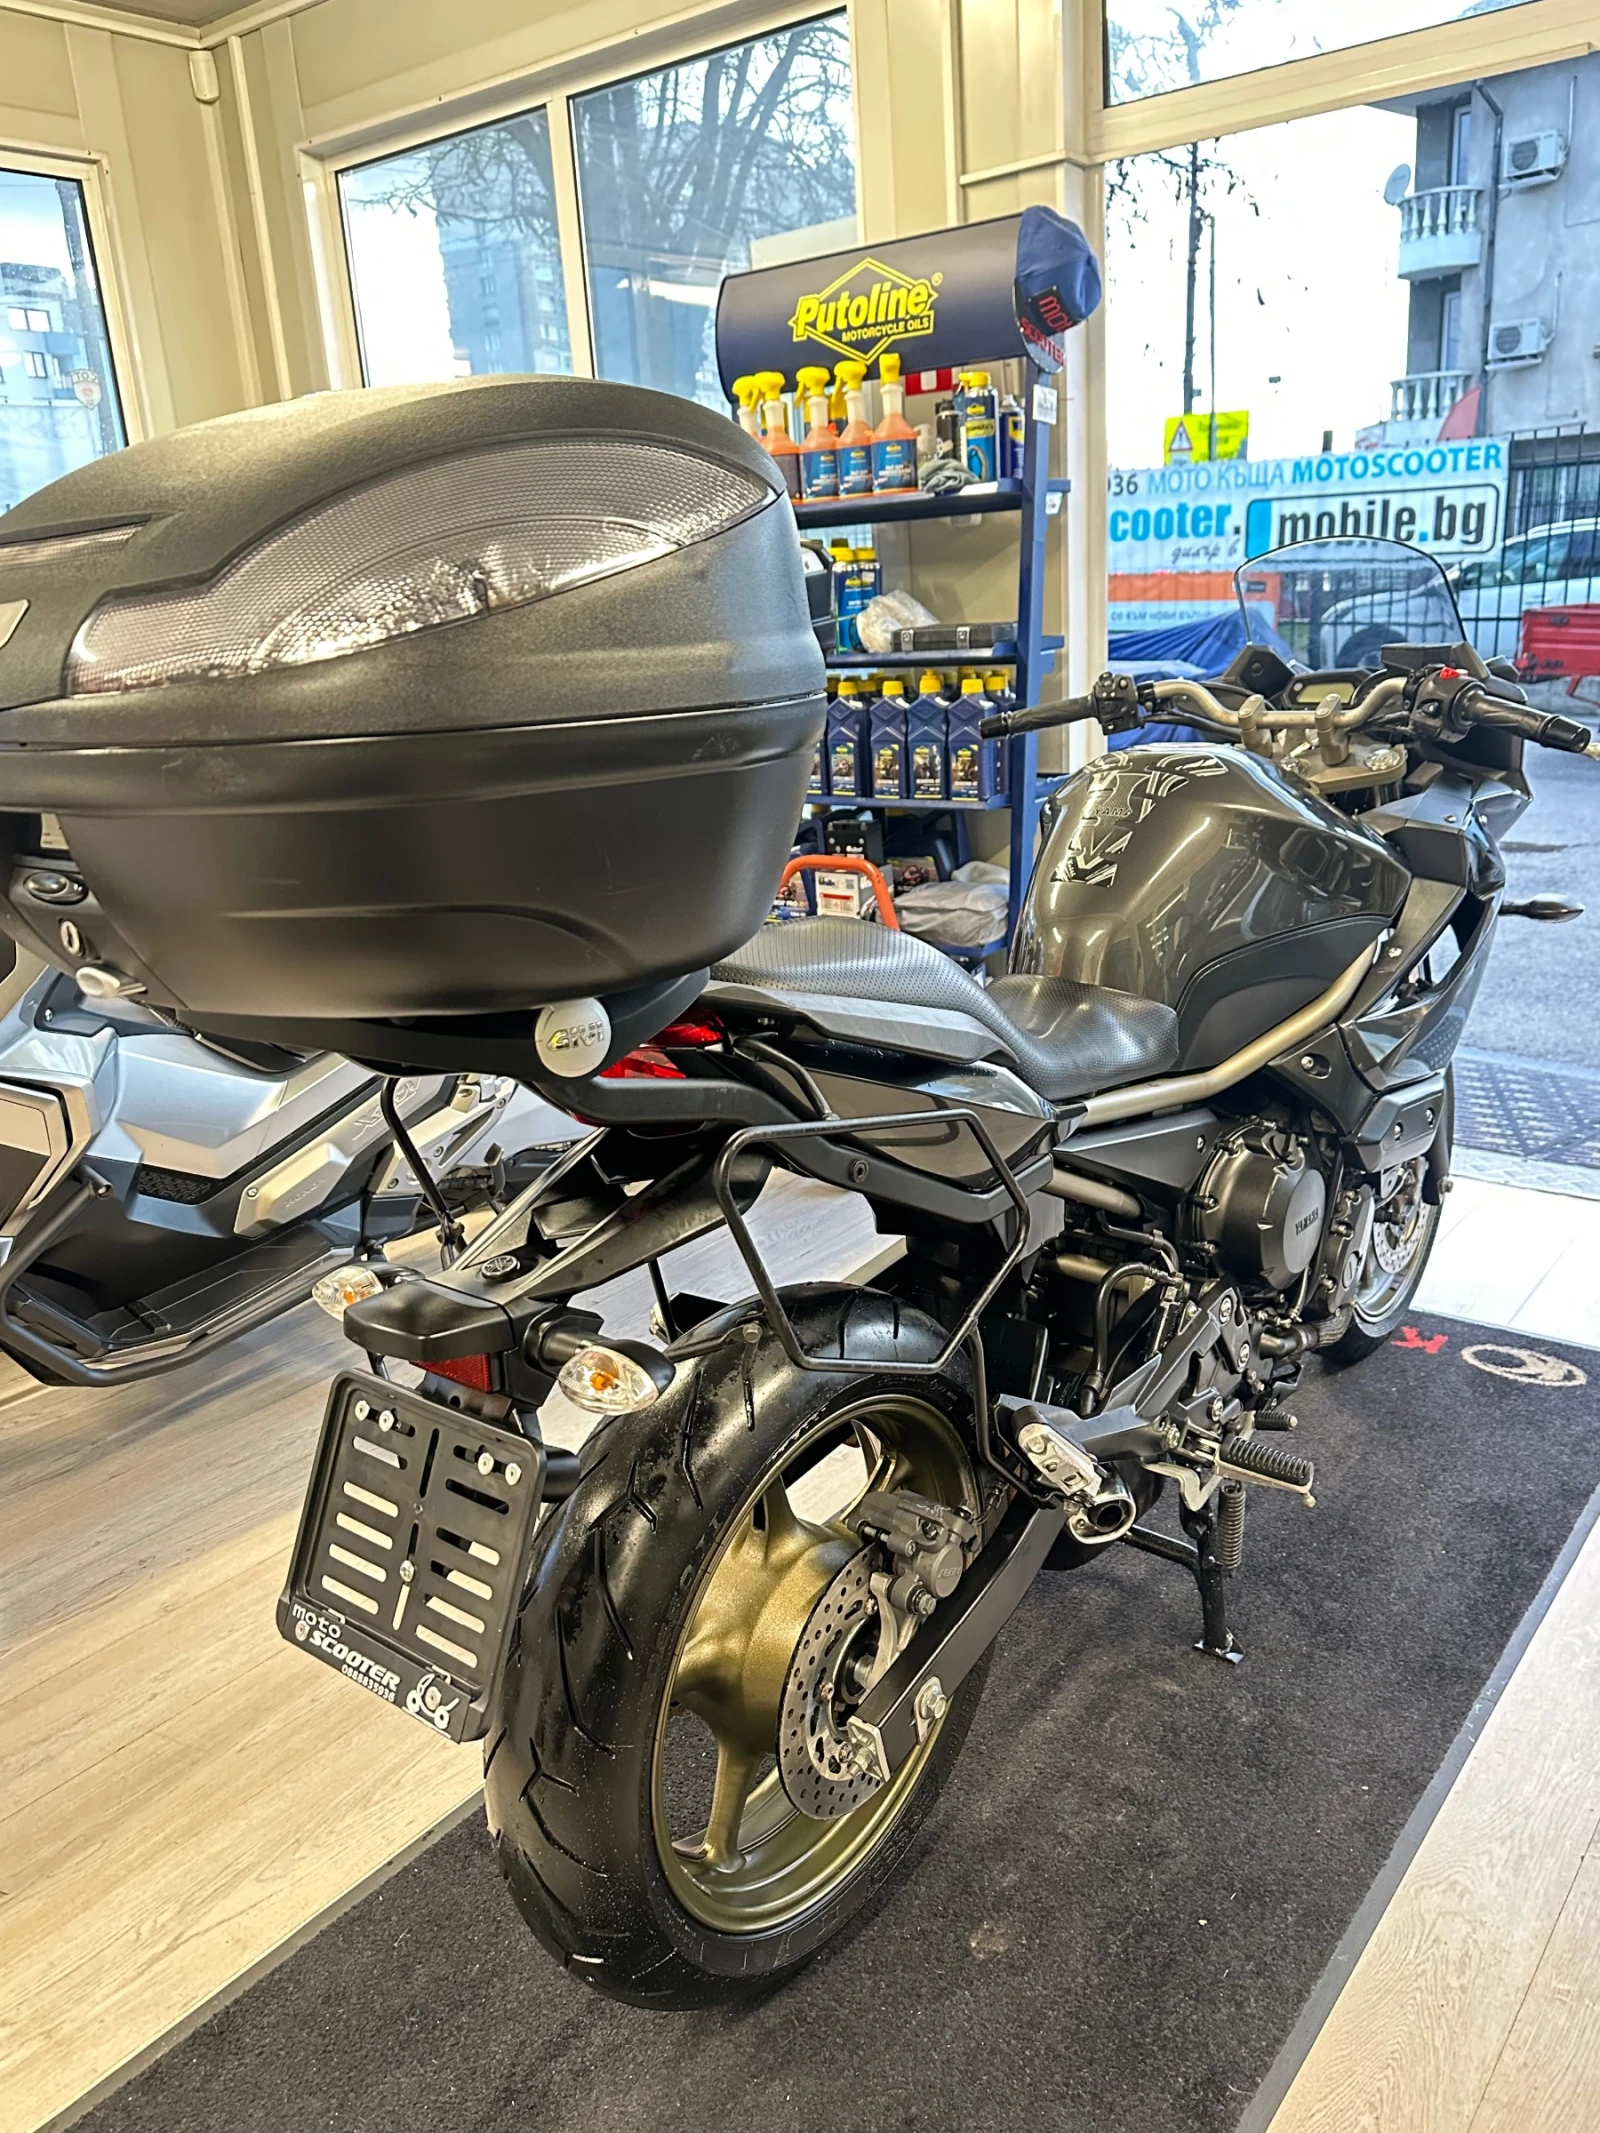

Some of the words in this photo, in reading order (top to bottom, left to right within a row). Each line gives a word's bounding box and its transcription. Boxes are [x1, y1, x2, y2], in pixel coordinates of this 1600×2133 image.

[796, 281, 929, 337] Putoline
[841, 321, 905, 342] MOTORCYCLE
[907, 317, 929, 331] OILS
[1107, 473, 1138, 496] 36
[1148, 467, 1210, 494] МОТО
[1217, 461, 1284, 490] КЪЩА
[1291, 444, 1502, 484] MOTOSCOOTER
[1279, 496, 1486, 548] mobile.bg
[1294, 1206, 1319, 1237] YAMAHA
[291, 1603, 342, 1640] moto
[308, 1629, 402, 1692] SCOOTER
